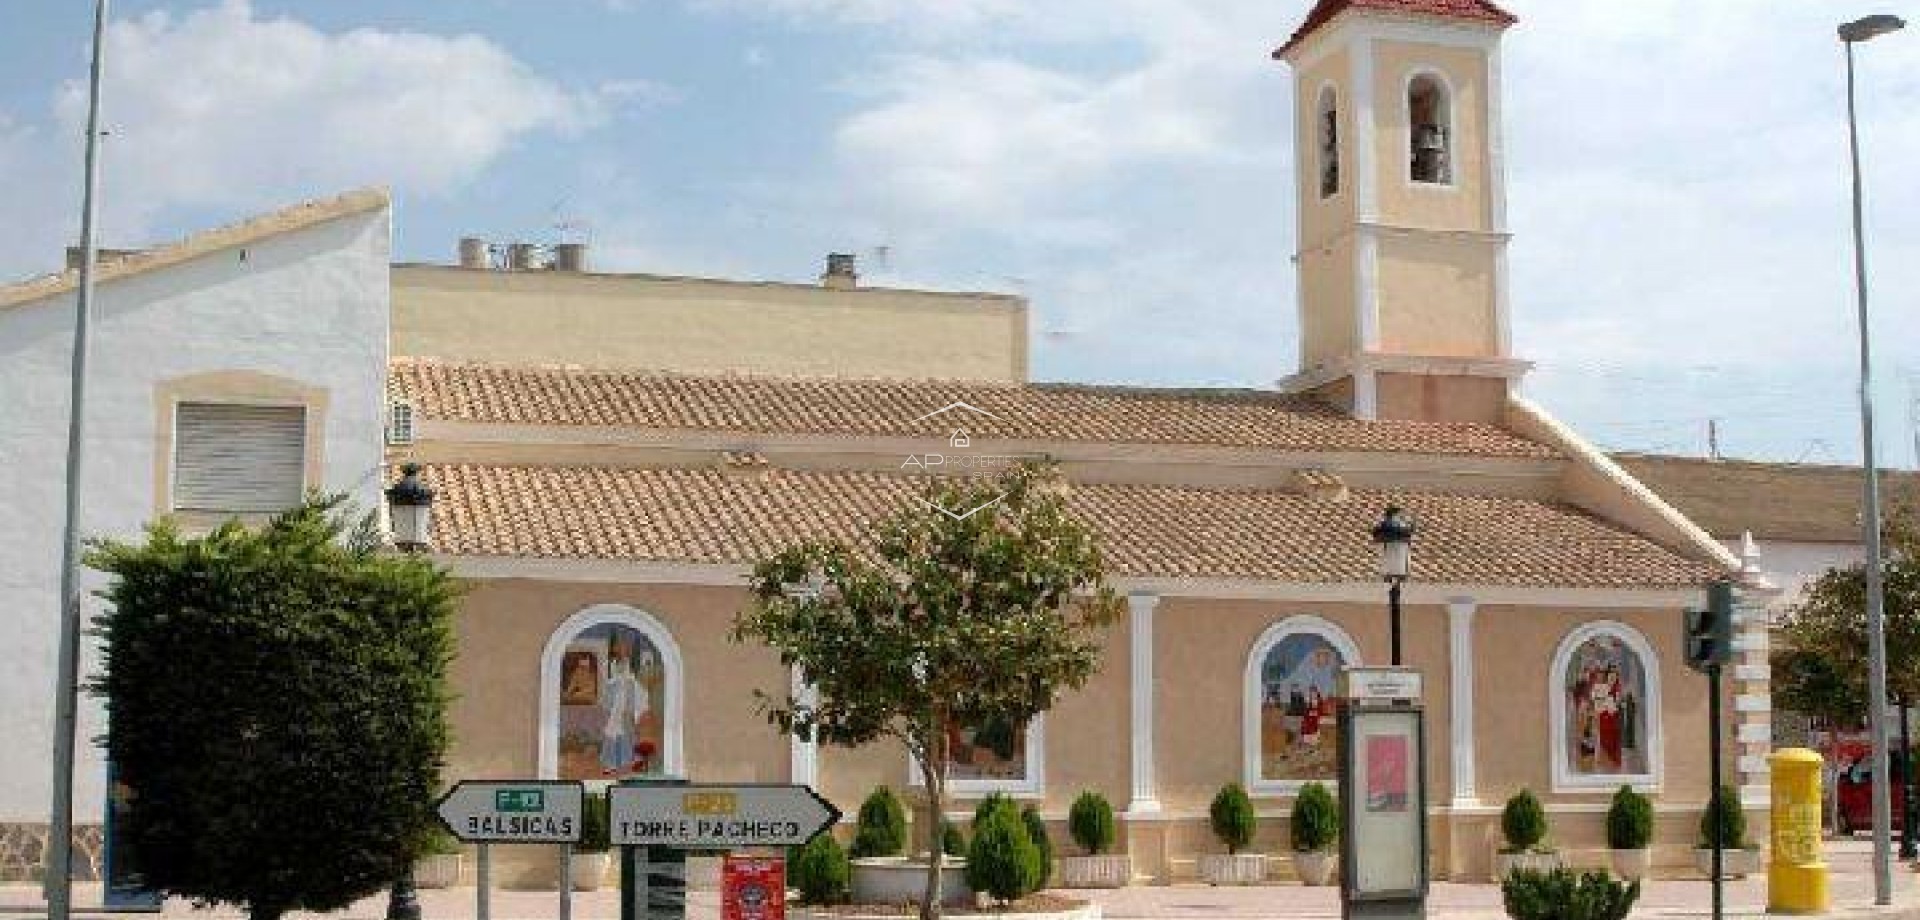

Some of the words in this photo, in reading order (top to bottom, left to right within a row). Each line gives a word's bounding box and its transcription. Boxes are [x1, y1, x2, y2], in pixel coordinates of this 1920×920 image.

[468, 816, 572, 835] BALSICAS
[618, 820, 689, 837] TORRE
[698, 820, 800, 837] PACHECO
